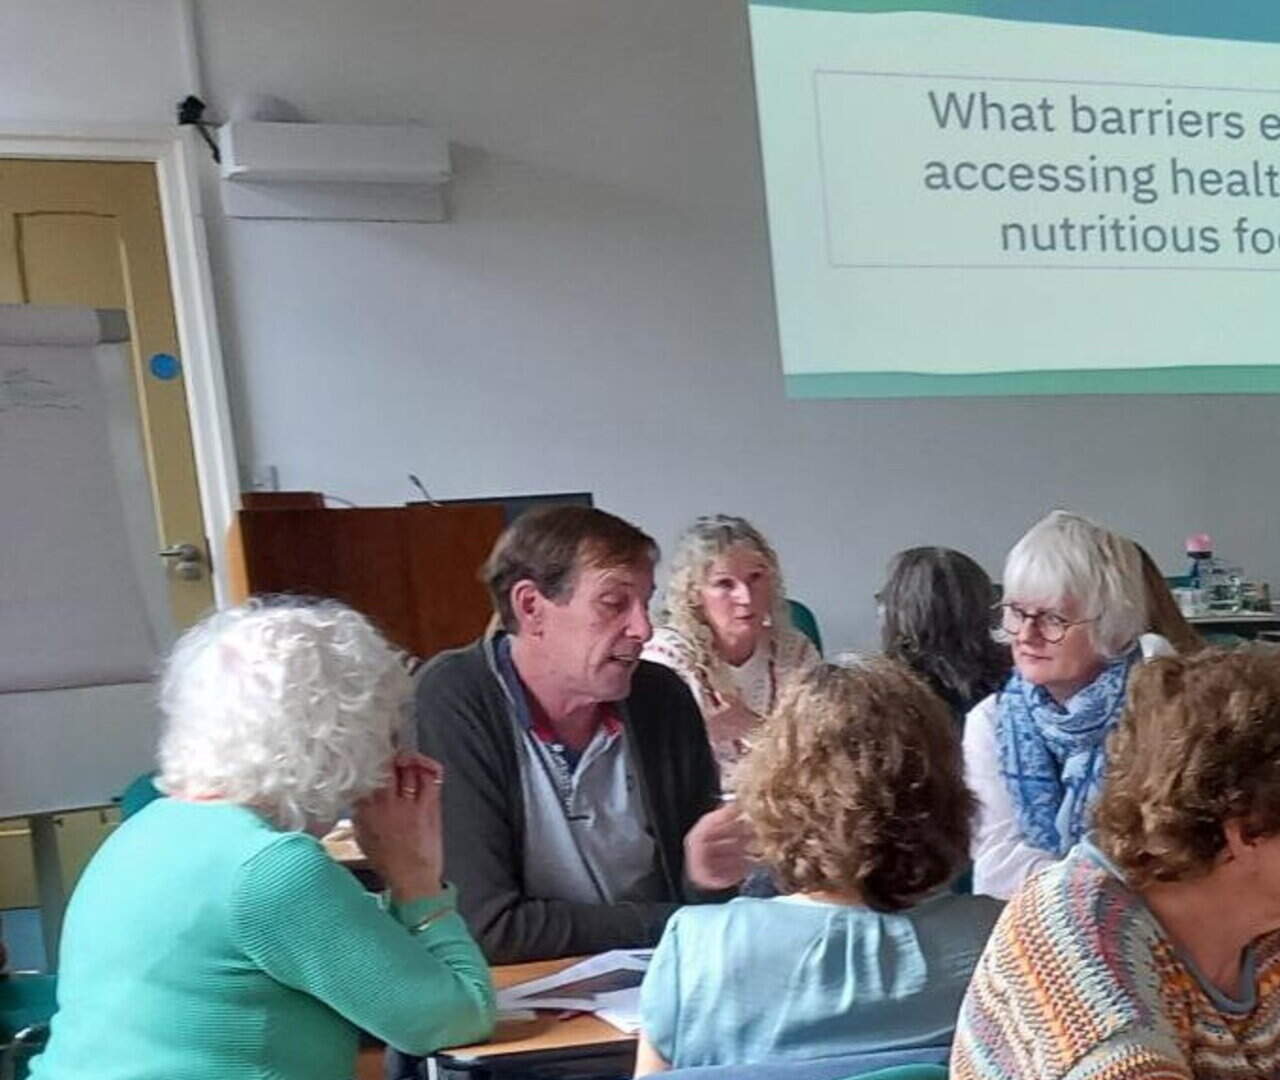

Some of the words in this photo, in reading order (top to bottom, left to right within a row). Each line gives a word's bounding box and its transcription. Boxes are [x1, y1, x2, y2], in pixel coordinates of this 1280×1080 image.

[927, 90, 1056, 133] What
[1070, 93, 1246, 140] barriers
[923, 154, 1159, 205] accessing
[1001, 214, 1221, 254] nutritious
